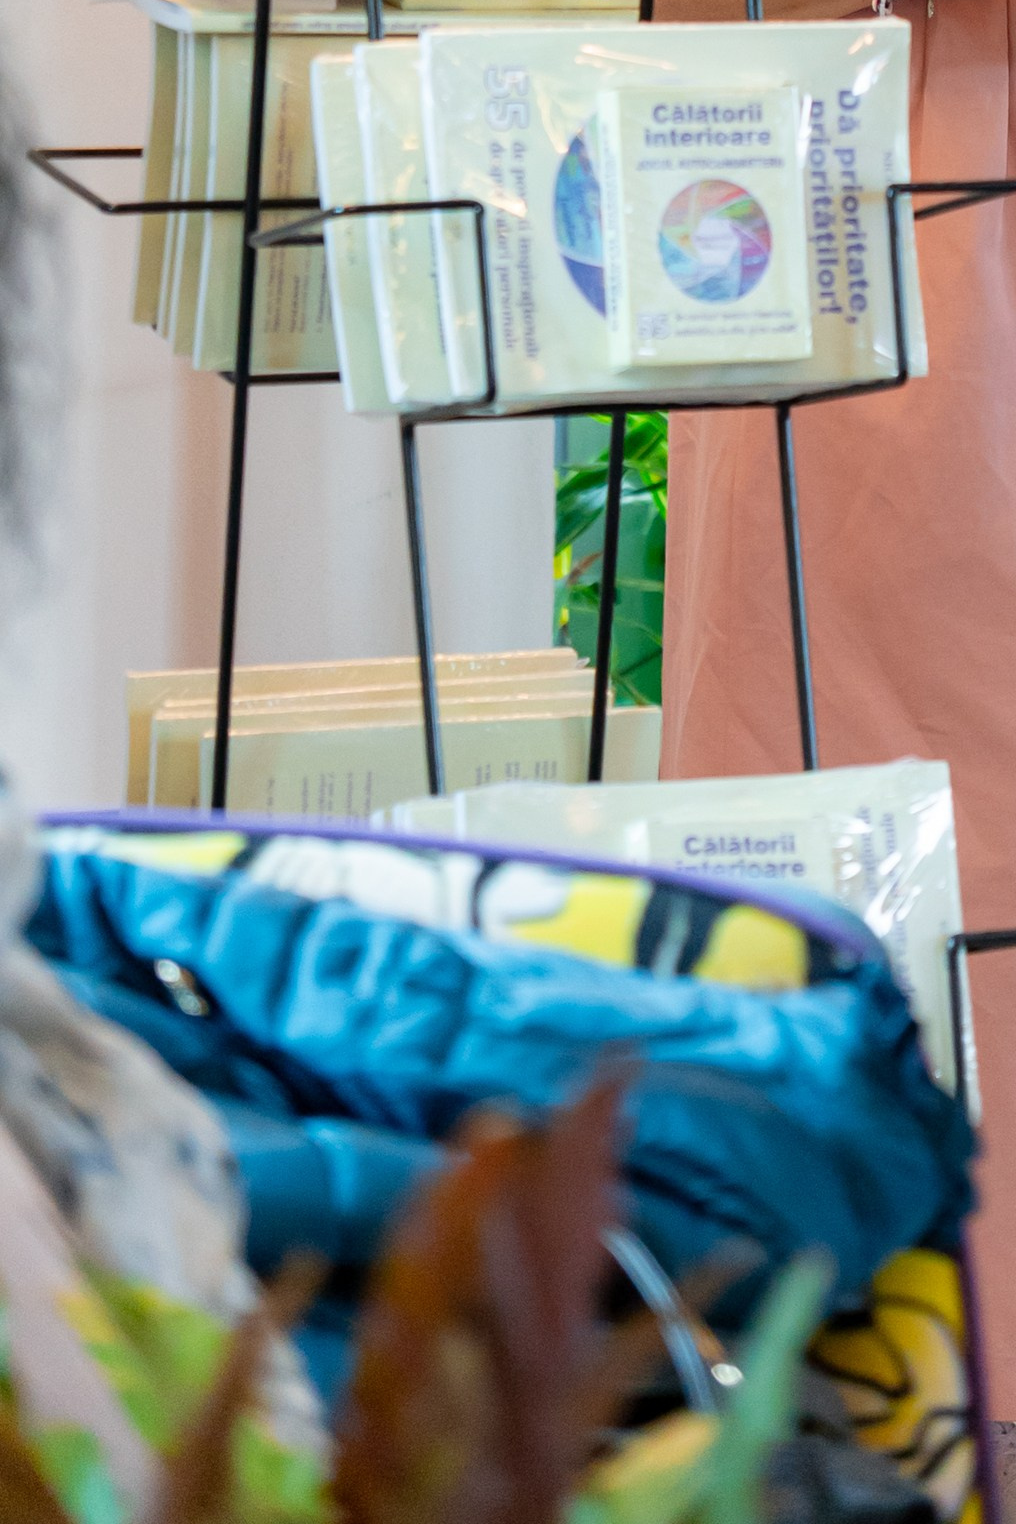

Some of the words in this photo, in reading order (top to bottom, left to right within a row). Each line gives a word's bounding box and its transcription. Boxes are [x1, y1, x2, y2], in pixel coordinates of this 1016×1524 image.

[652, 101, 763, 124] Călătorii
[483, 64, 530, 133] 55
[510, 167, 531, 231] povti
[644, 127, 771, 147] interioare
[833, 147, 869, 324] prioritate,
[683, 833, 796, 855] Călătorii
